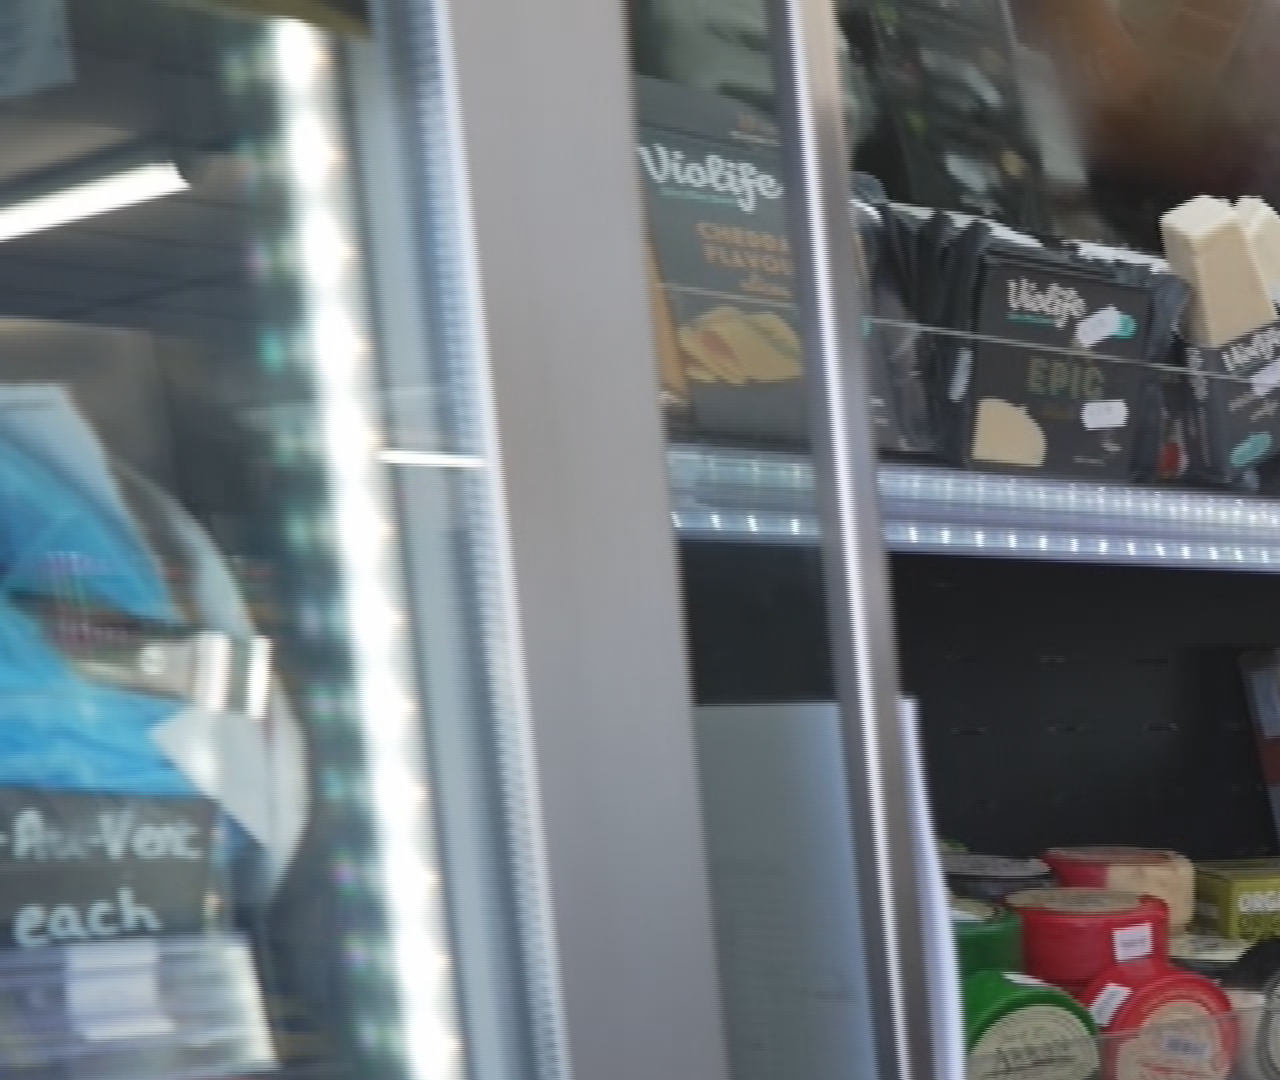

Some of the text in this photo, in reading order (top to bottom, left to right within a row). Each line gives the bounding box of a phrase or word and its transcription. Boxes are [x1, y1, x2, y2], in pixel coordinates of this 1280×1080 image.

[639, 144, 784, 213] Violife
[696, 221, 792, 254] CHEDDA
[1006, 276, 1087, 330] Violife
[1026, 357, 1105, 400] EPIC
[13, 886, 162, 948] each
